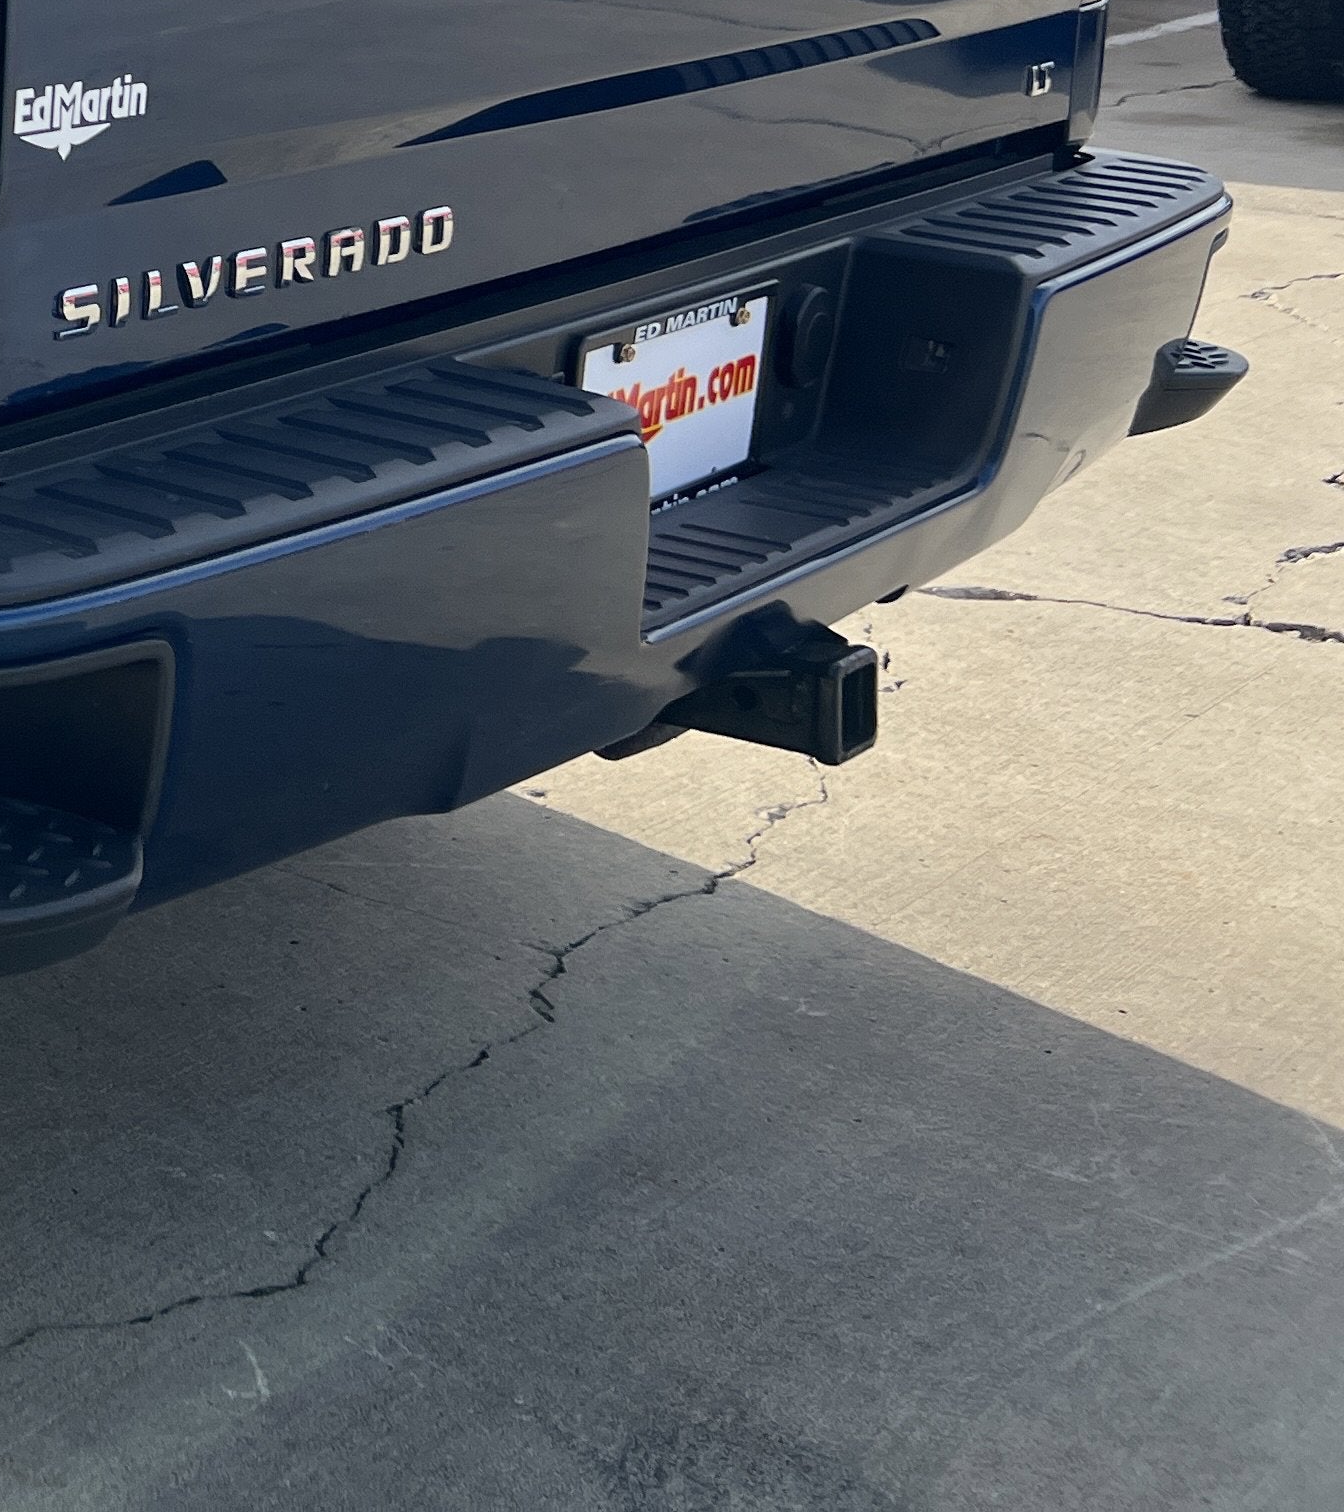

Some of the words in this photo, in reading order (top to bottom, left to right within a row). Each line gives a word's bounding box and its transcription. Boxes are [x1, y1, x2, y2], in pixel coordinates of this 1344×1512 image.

[53, 205, 455, 341] SILVERADO
[634, 322, 662, 343] ED
[665, 297, 739, 335] MARTIN
